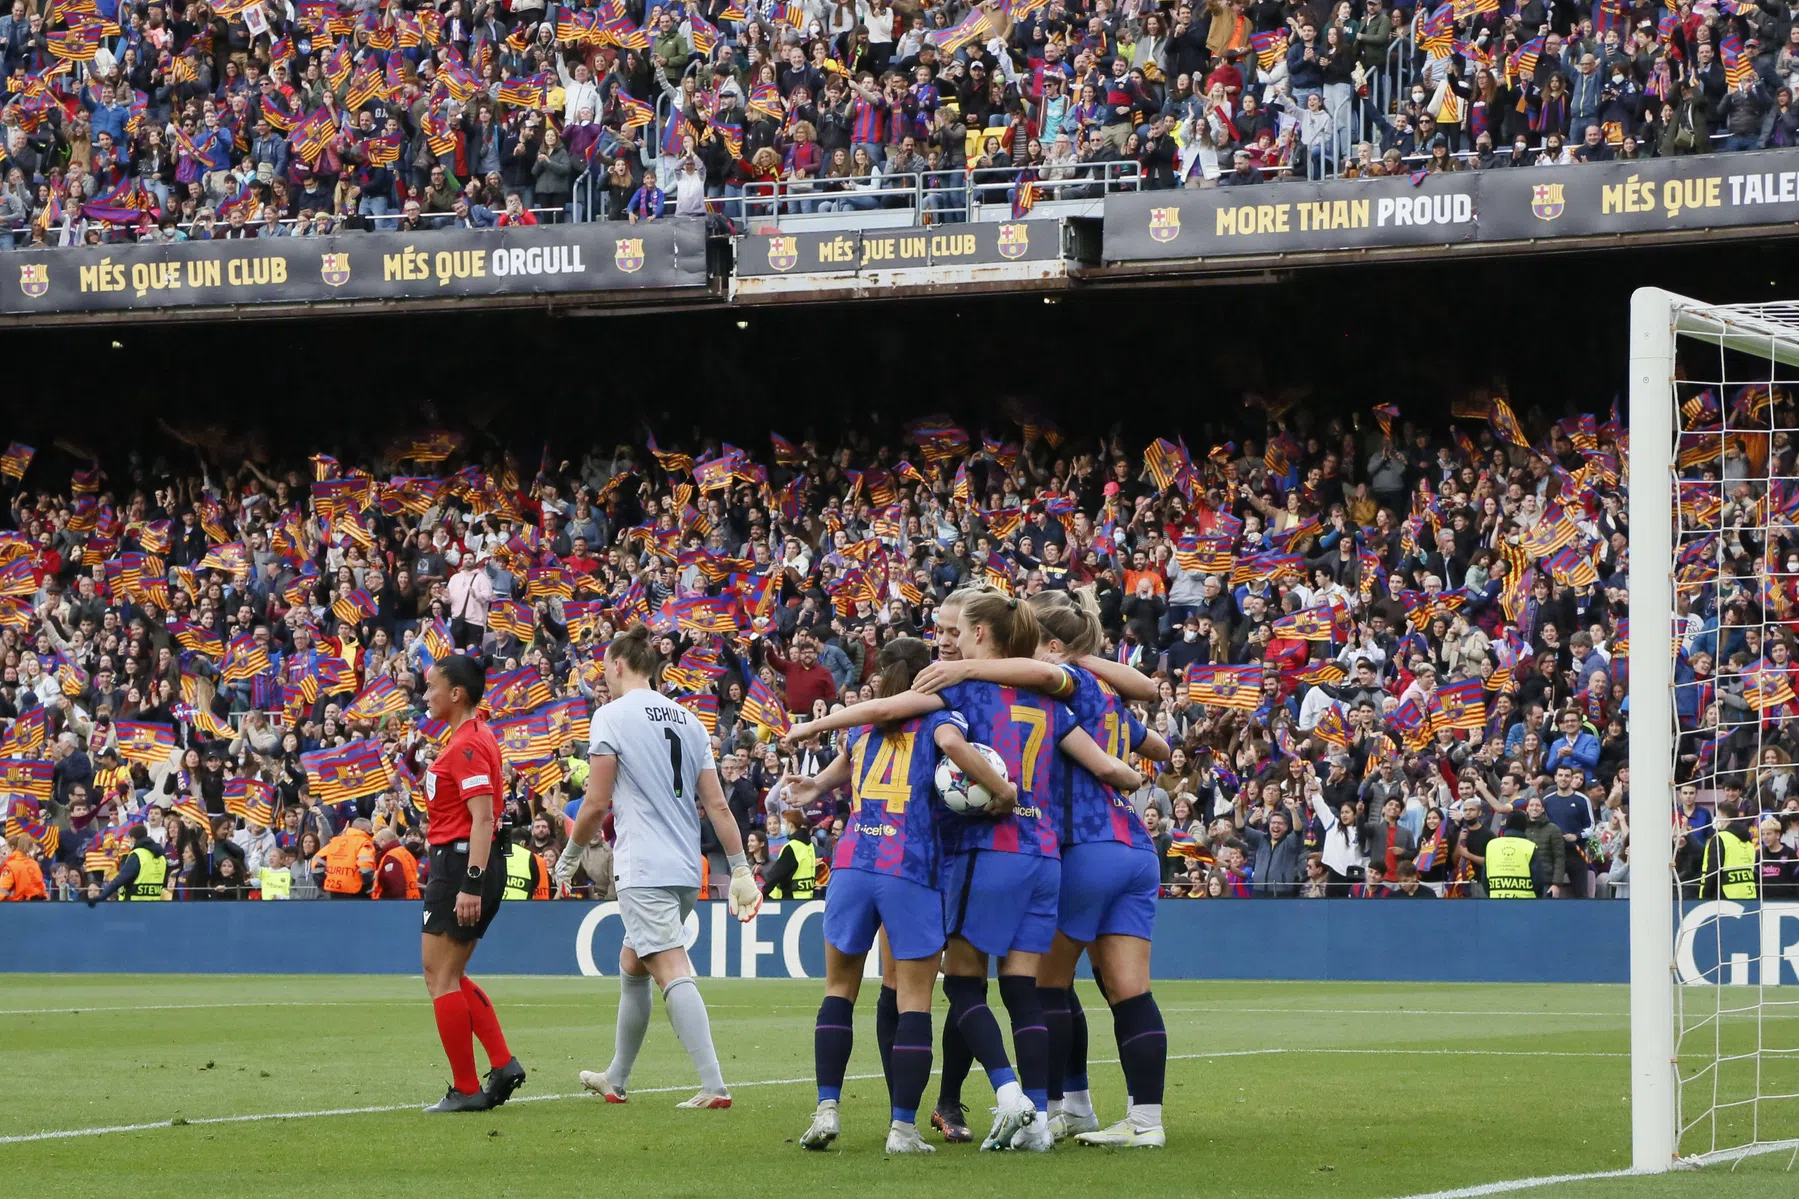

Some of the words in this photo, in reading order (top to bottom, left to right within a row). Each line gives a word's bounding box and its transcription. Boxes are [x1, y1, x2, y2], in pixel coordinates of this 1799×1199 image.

[1216, 204, 1290, 236] MORE
[1297, 199, 1369, 232] THAN
[1377, 194, 1472, 227] PROUD
[1602, 174, 1655, 215] MÉS
[1663, 177, 1722, 219] QUE
[1728, 171, 1799, 205] TALE
[384, 245, 430, 281] MÉS
[435, 250, 486, 287] QUE
[492, 245, 585, 277] ORGULL
[819, 236, 853, 262] MÉS
[900, 237, 926, 258] UN
[931, 234, 976, 257] CLUB
[80, 258, 126, 293] MÉS
[132, 261, 181, 298] QUE
[187, 259, 221, 287] UN
[228, 257, 287, 286] CLUB
[645, 706, 687, 726] SCHULT
[664, 727, 683, 798] 1
[1010, 705, 1047, 792] 7
[1104, 711, 1131, 797] 11
[851, 731, 917, 814] 14
[854, 823, 883, 836] uicef
[137, 885, 163, 895] STEW
[328, 865, 357, 877] CURITY
[1489, 878, 1534, 889] STEWARD
[1728, 870, 1755, 882] STEW
